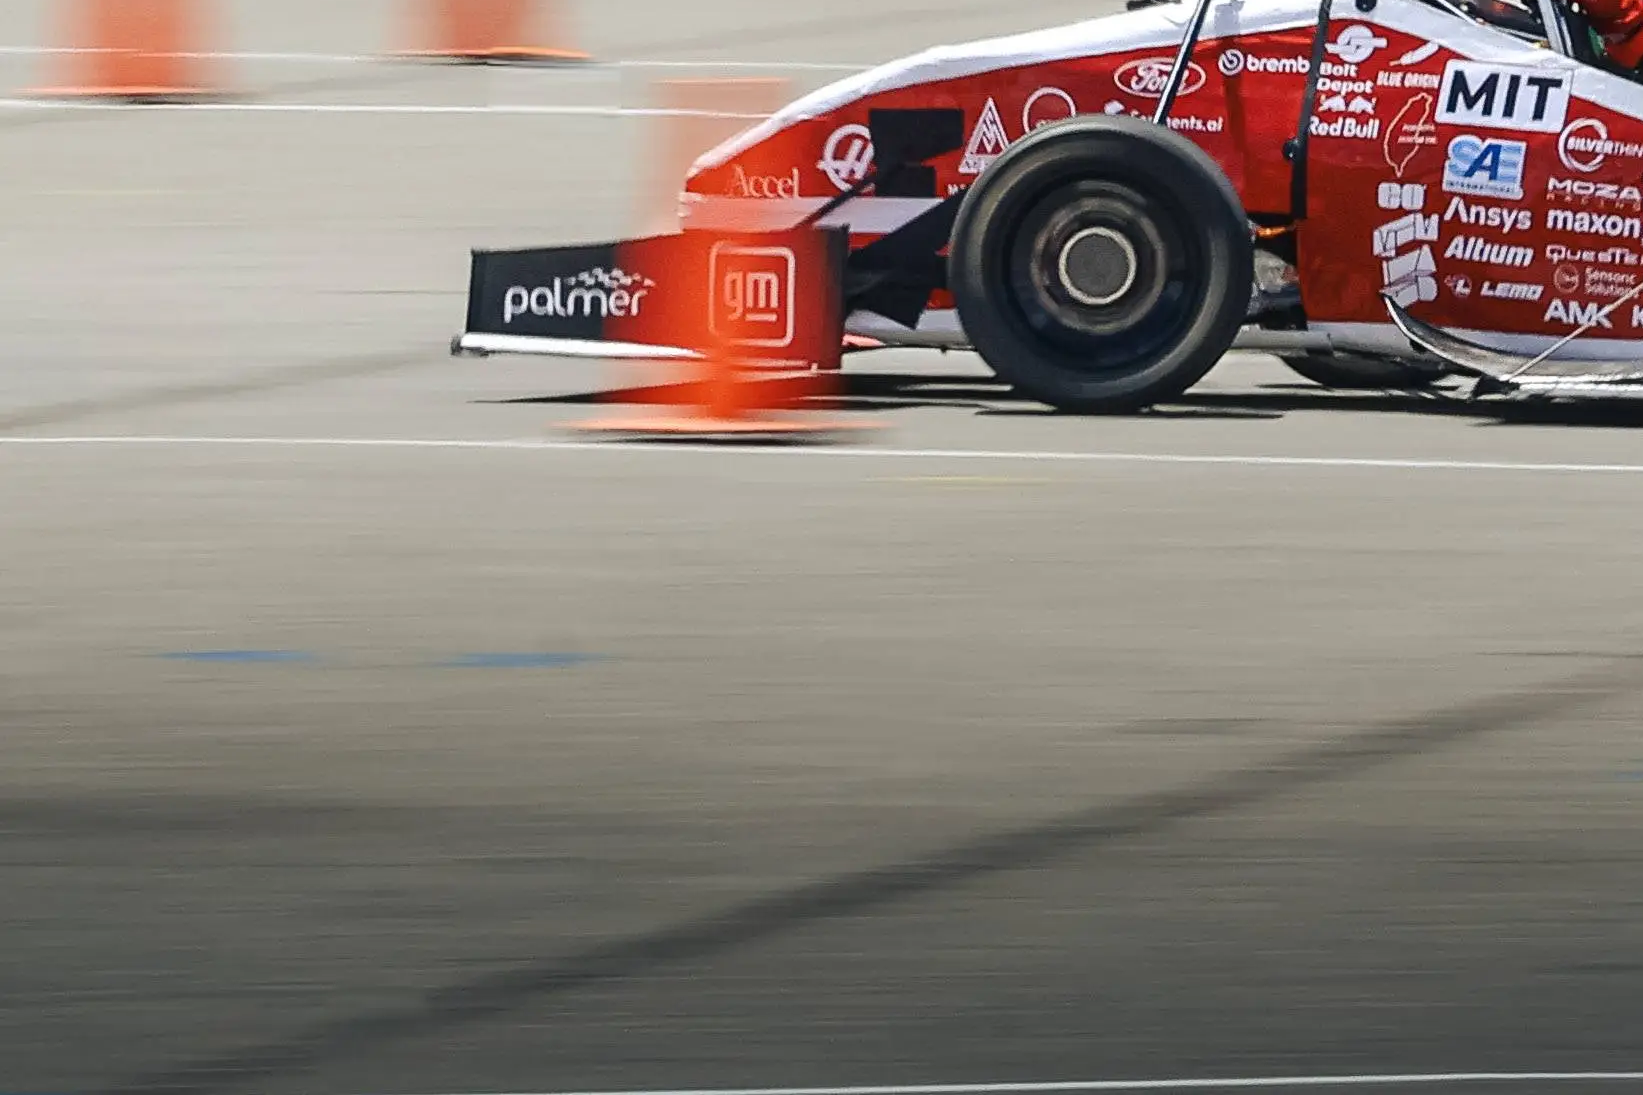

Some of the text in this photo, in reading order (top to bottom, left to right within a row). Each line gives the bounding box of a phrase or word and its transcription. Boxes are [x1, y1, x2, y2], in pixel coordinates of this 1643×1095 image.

[1246, 54, 1311, 73] bremb
[1319, 62, 1358, 77] Bolt
[1317, 77, 1374, 96] Depot
[1446, 70, 1563, 122] MIT
[1447, 139, 1522, 182] SAE
[725, 163, 800, 199] Accel
[1548, 176, 1641, 201] MOZA
[1444, 196, 1532, 235] Ansys
[1546, 208, 1641, 238] maxon
[1444, 234, 1535, 267] Altium
[504, 276, 649, 324] palmer
[724, 271, 780, 321] gm
[1544, 298, 1613, 329] AMK
